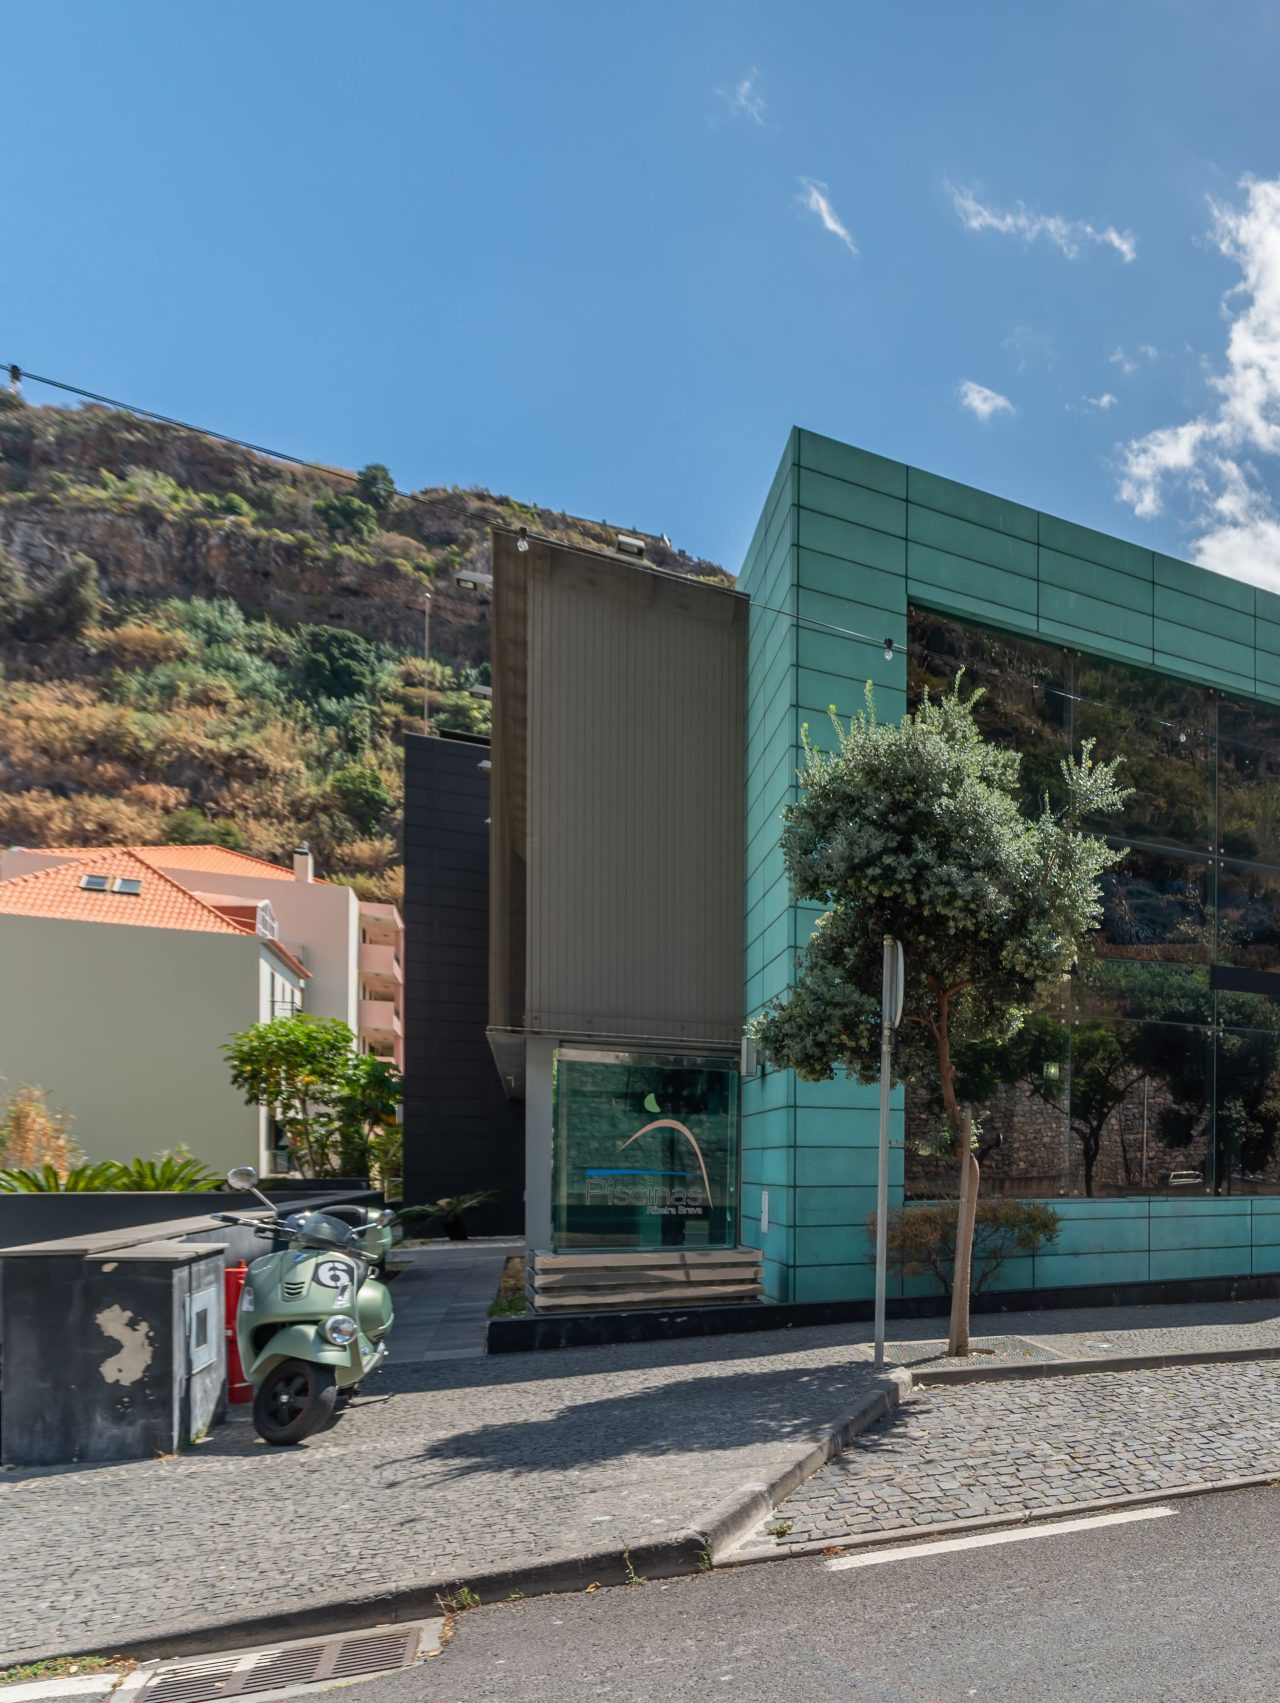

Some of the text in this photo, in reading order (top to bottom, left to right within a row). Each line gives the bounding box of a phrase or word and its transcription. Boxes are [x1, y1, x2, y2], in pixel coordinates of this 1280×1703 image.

[585, 1179, 702, 1206] Piscinas
[647, 1206, 703, 1215] Ribeira Brava
[317, 1261, 350, 1288] 6
